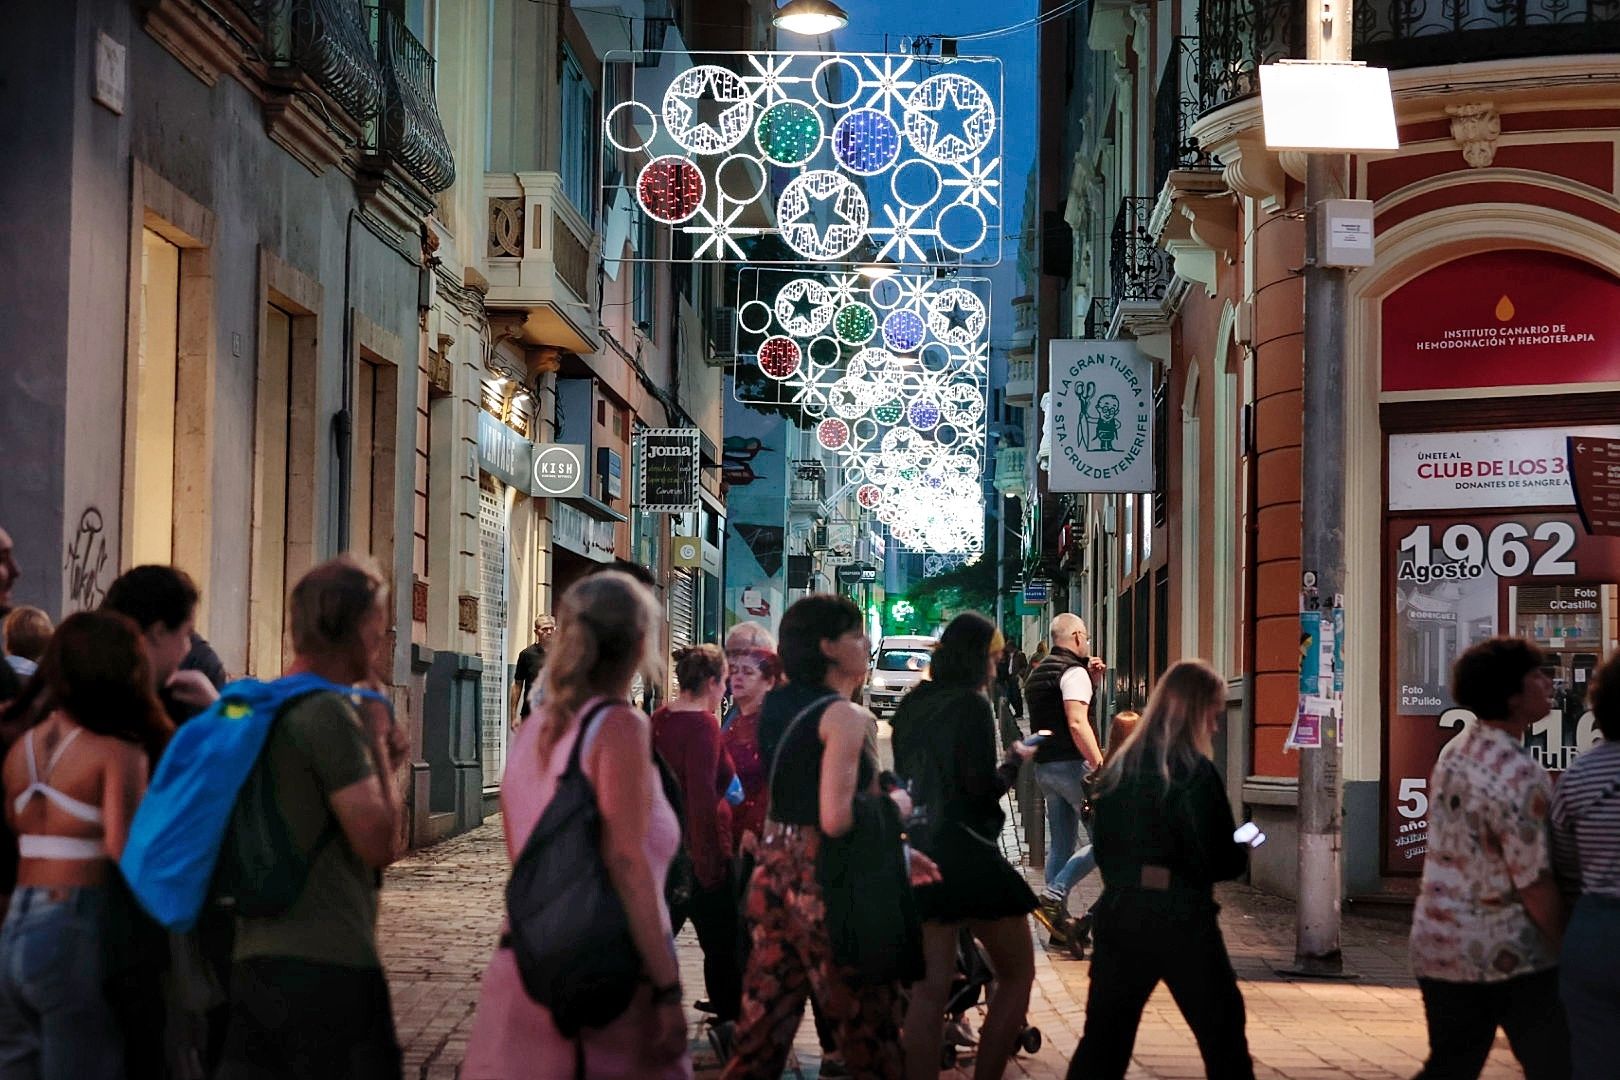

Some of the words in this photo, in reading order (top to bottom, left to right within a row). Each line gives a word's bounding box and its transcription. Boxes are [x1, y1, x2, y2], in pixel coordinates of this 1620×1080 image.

[1444, 328, 1498, 339] INSTITUTO
[1499, 325, 1550, 336] CANARIO
[1552, 324, 1566, 333] DE
[1416, 336, 1506, 350] HEMODONACIÓN
[1508, 337, 1515, 346] Y
[1517, 333, 1595, 346] HEMOTERAPIA
[1057, 379, 1072, 397] LA
[1069, 353, 1105, 377] GRAN
[1109, 355, 1142, 397] TIJERA
[482, 421, 515, 476] VINTAGE
[1064, 446, 1095, 477] CRUZ
[1111, 414, 1148, 476] TENERIFE
[1417, 451, 1448, 461] ÚNETE
[1449, 452, 1461, 460] AL
[541, 462, 573, 475] KISH
[1417, 461, 1473, 479] CLUB
[1477, 460, 1503, 477] DE
[1508, 458, 1548, 476] LOS
[1551, 457, 1569, 473] 3
[1455, 480, 1506, 490] DONANTES
[1508, 480, 1520, 488] DE
[1522, 479, 1561, 487] SANGRE
[1400, 521, 1577, 577] 1962
[1399, 561, 1483, 583] Agosto
[1574, 588, 1598, 598] Foto
[1550, 600, 1598, 610] C/Castillo
[1402, 685, 1424, 695] Foto
[1402, 697, 1442, 707] R.Pulido
[1438, 708, 1605, 764] 216
[1397, 778, 1429, 819] 5
[1399, 820, 1429, 833] año
